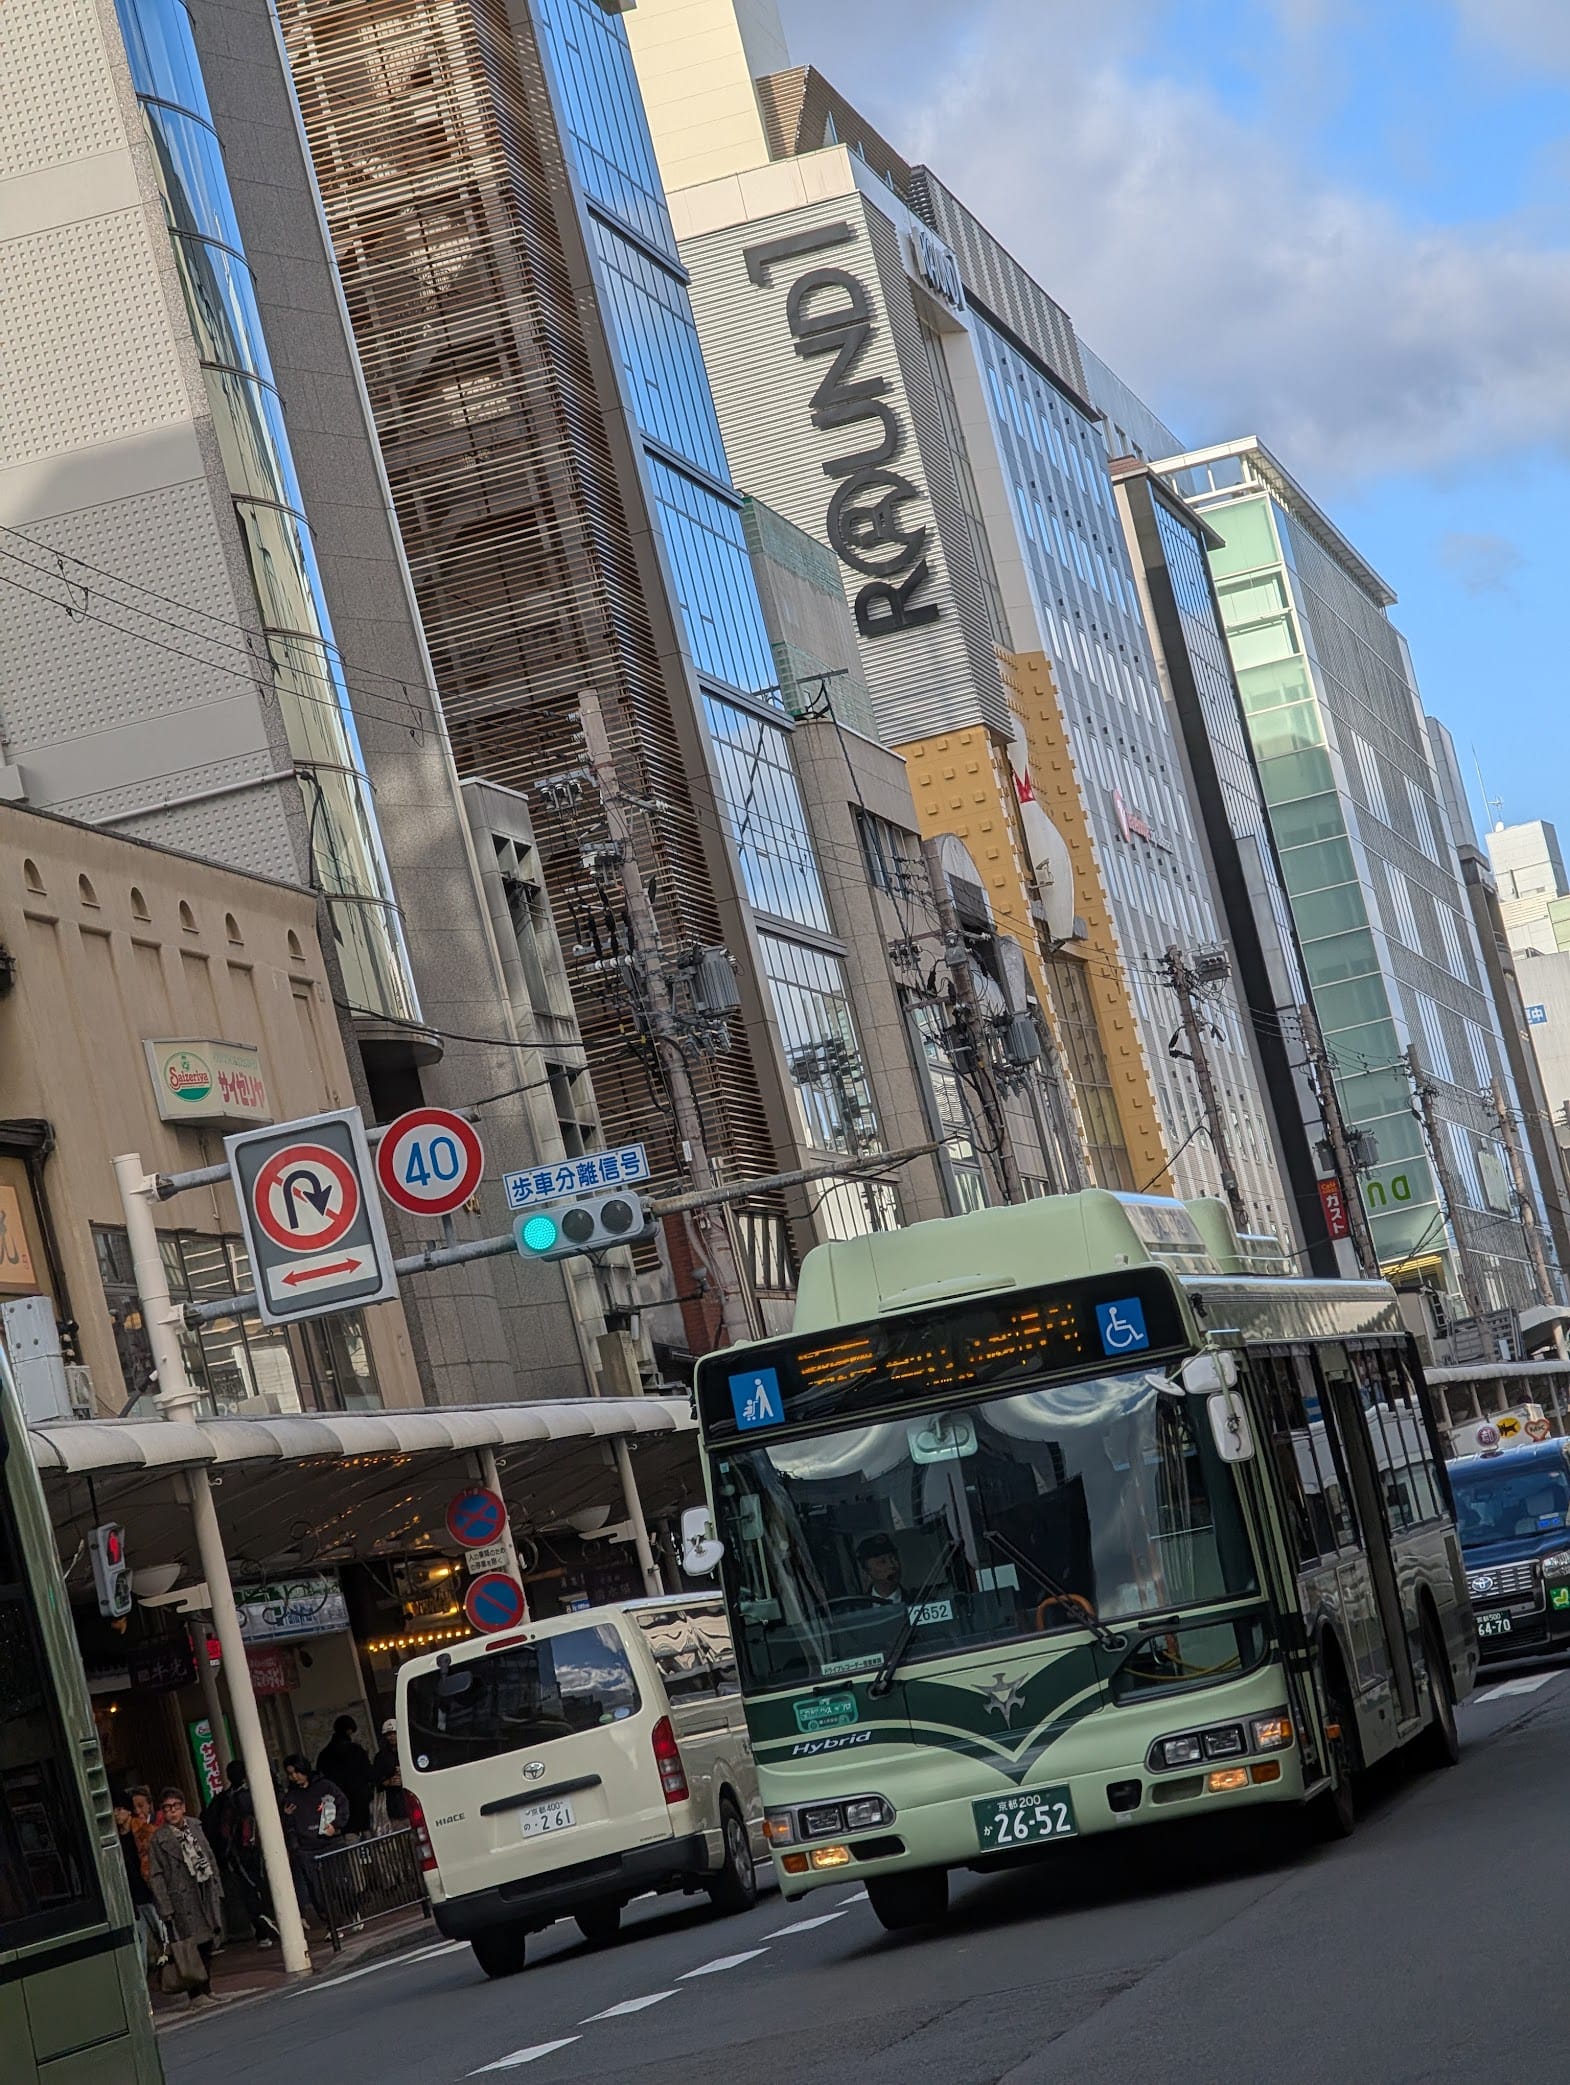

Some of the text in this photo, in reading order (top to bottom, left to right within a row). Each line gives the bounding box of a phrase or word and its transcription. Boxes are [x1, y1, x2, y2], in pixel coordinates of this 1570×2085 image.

[217, 1070, 265, 1109] サイゼリヤ
[405, 1136, 459, 1186] 40
[511, 1150, 641, 1202] 歩車分離信号
[1326, 1193, 1344, 1234] ガスト
[913, 1602, 948, 1624] 2652
[1478, 1618, 1511, 1636] 64-70
[792, 1731, 872, 1755] Hybrid
[997, 1794, 1041, 1812] 京都200
[435, 1812, 466, 1828] HIACE
[983, 1802, 1071, 1844] か 26-52
